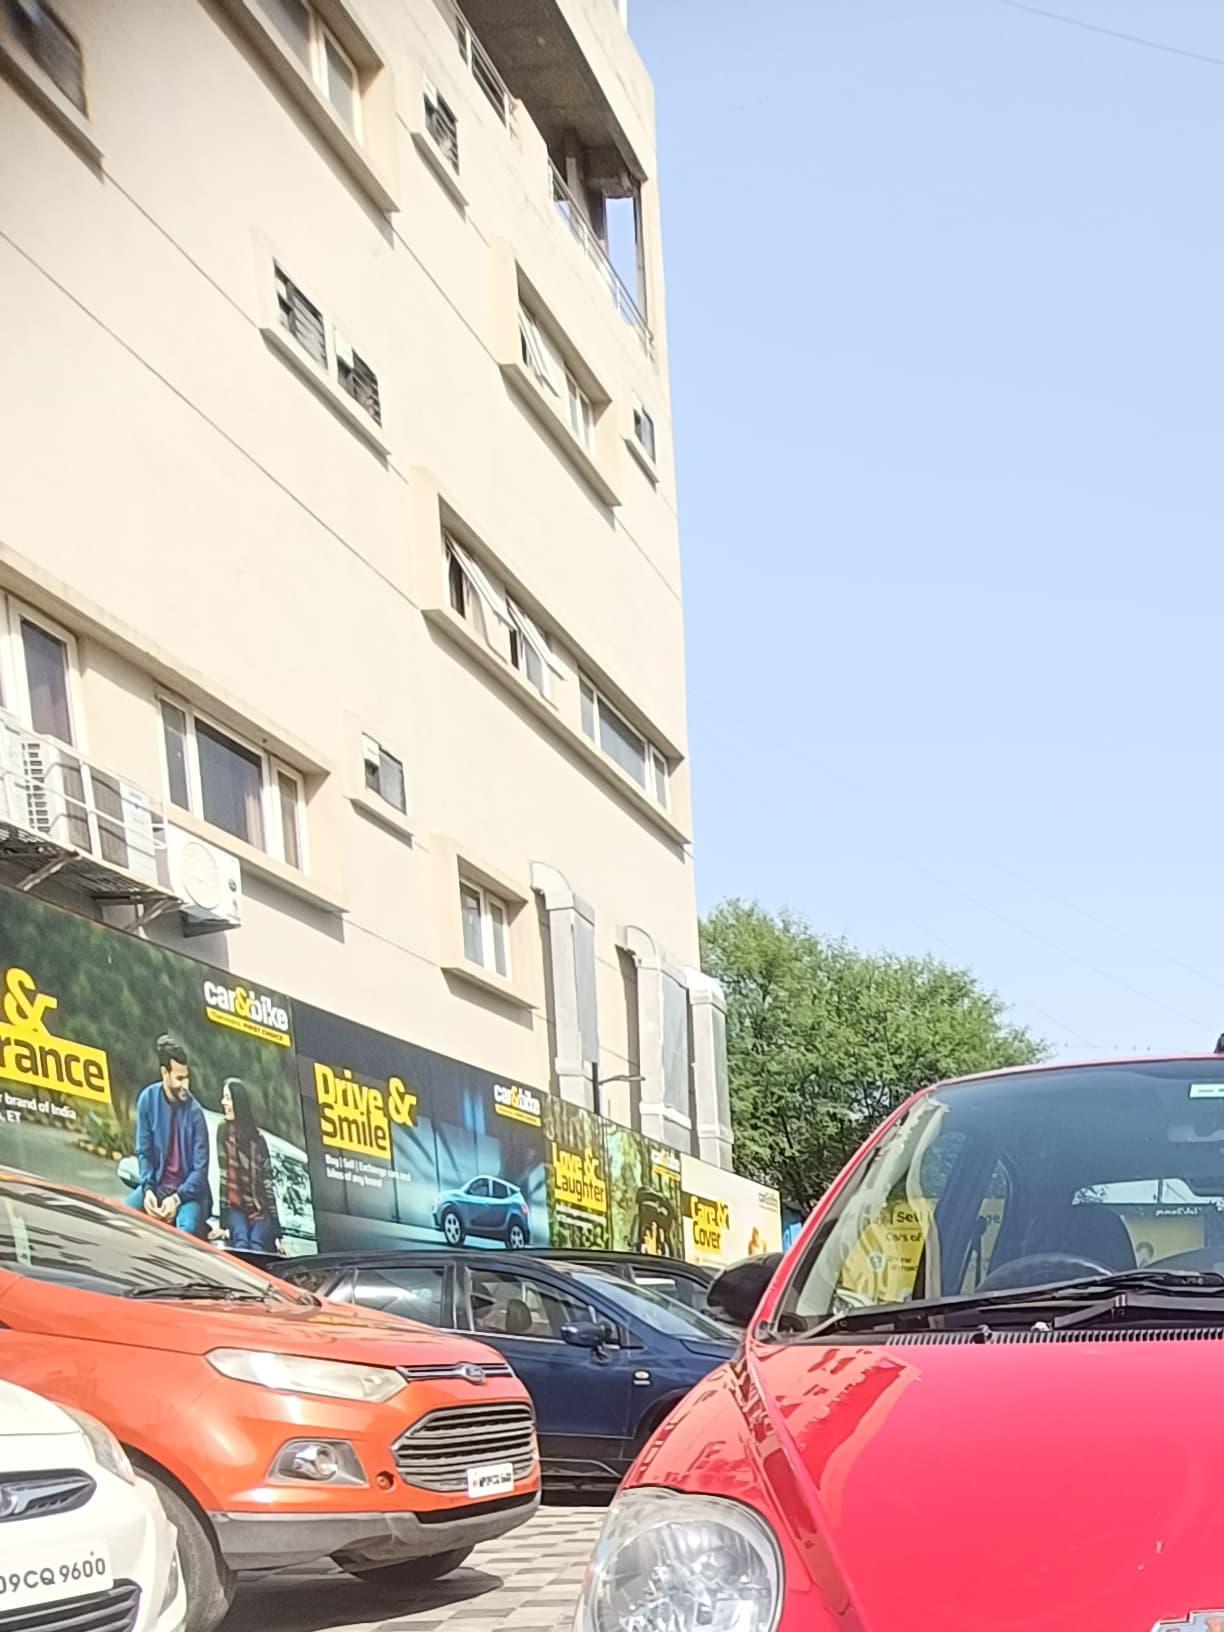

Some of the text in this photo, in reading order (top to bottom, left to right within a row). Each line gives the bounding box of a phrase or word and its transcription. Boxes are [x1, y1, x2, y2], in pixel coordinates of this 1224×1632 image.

[204, 981, 288, 1031] car&bike
[38, 1100, 50, 1114] of
[51, 1104, 77, 1120] India
[314, 1062, 417, 1128] Drive &
[320, 1102, 387, 1151] Smile
[552, 1142, 599, 1177] Love &
[555, 1162, 604, 1203] Laughter
[692, 1221, 721, 1250] Cover
[59, 1557, 106, 1583] 9600
